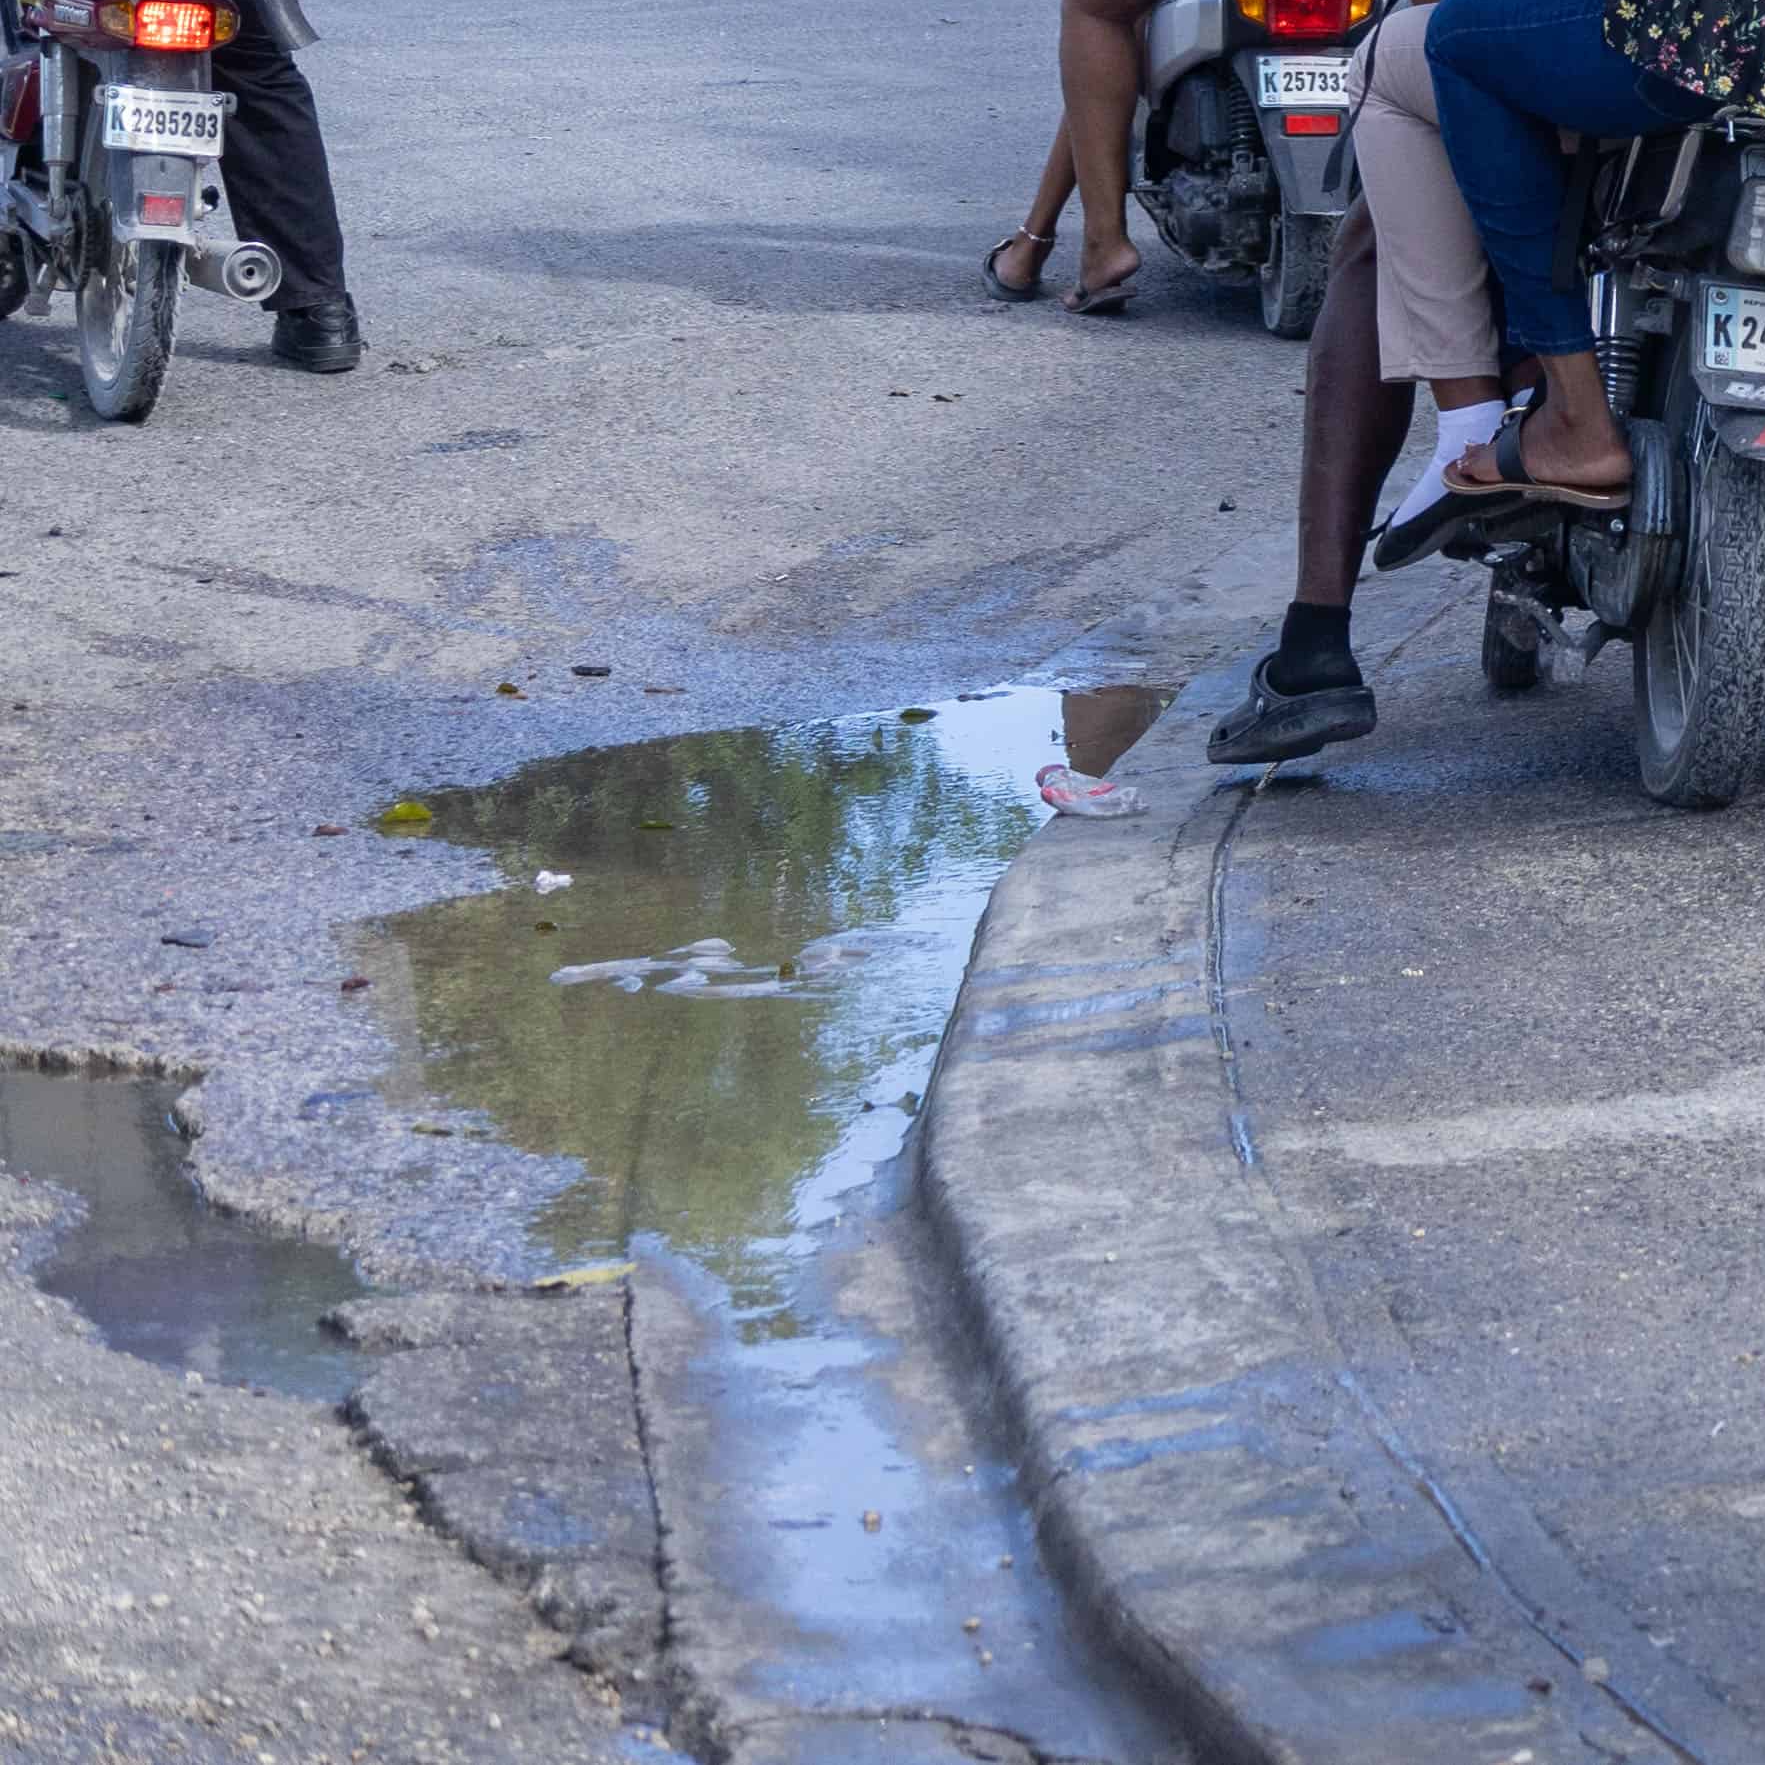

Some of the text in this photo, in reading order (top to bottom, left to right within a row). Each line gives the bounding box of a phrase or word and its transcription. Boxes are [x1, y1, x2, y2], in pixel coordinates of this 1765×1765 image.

[1264, 72, 1277, 93] K
[112, 105, 218, 139] K 2295293
[1712, 313, 1733, 348] K
